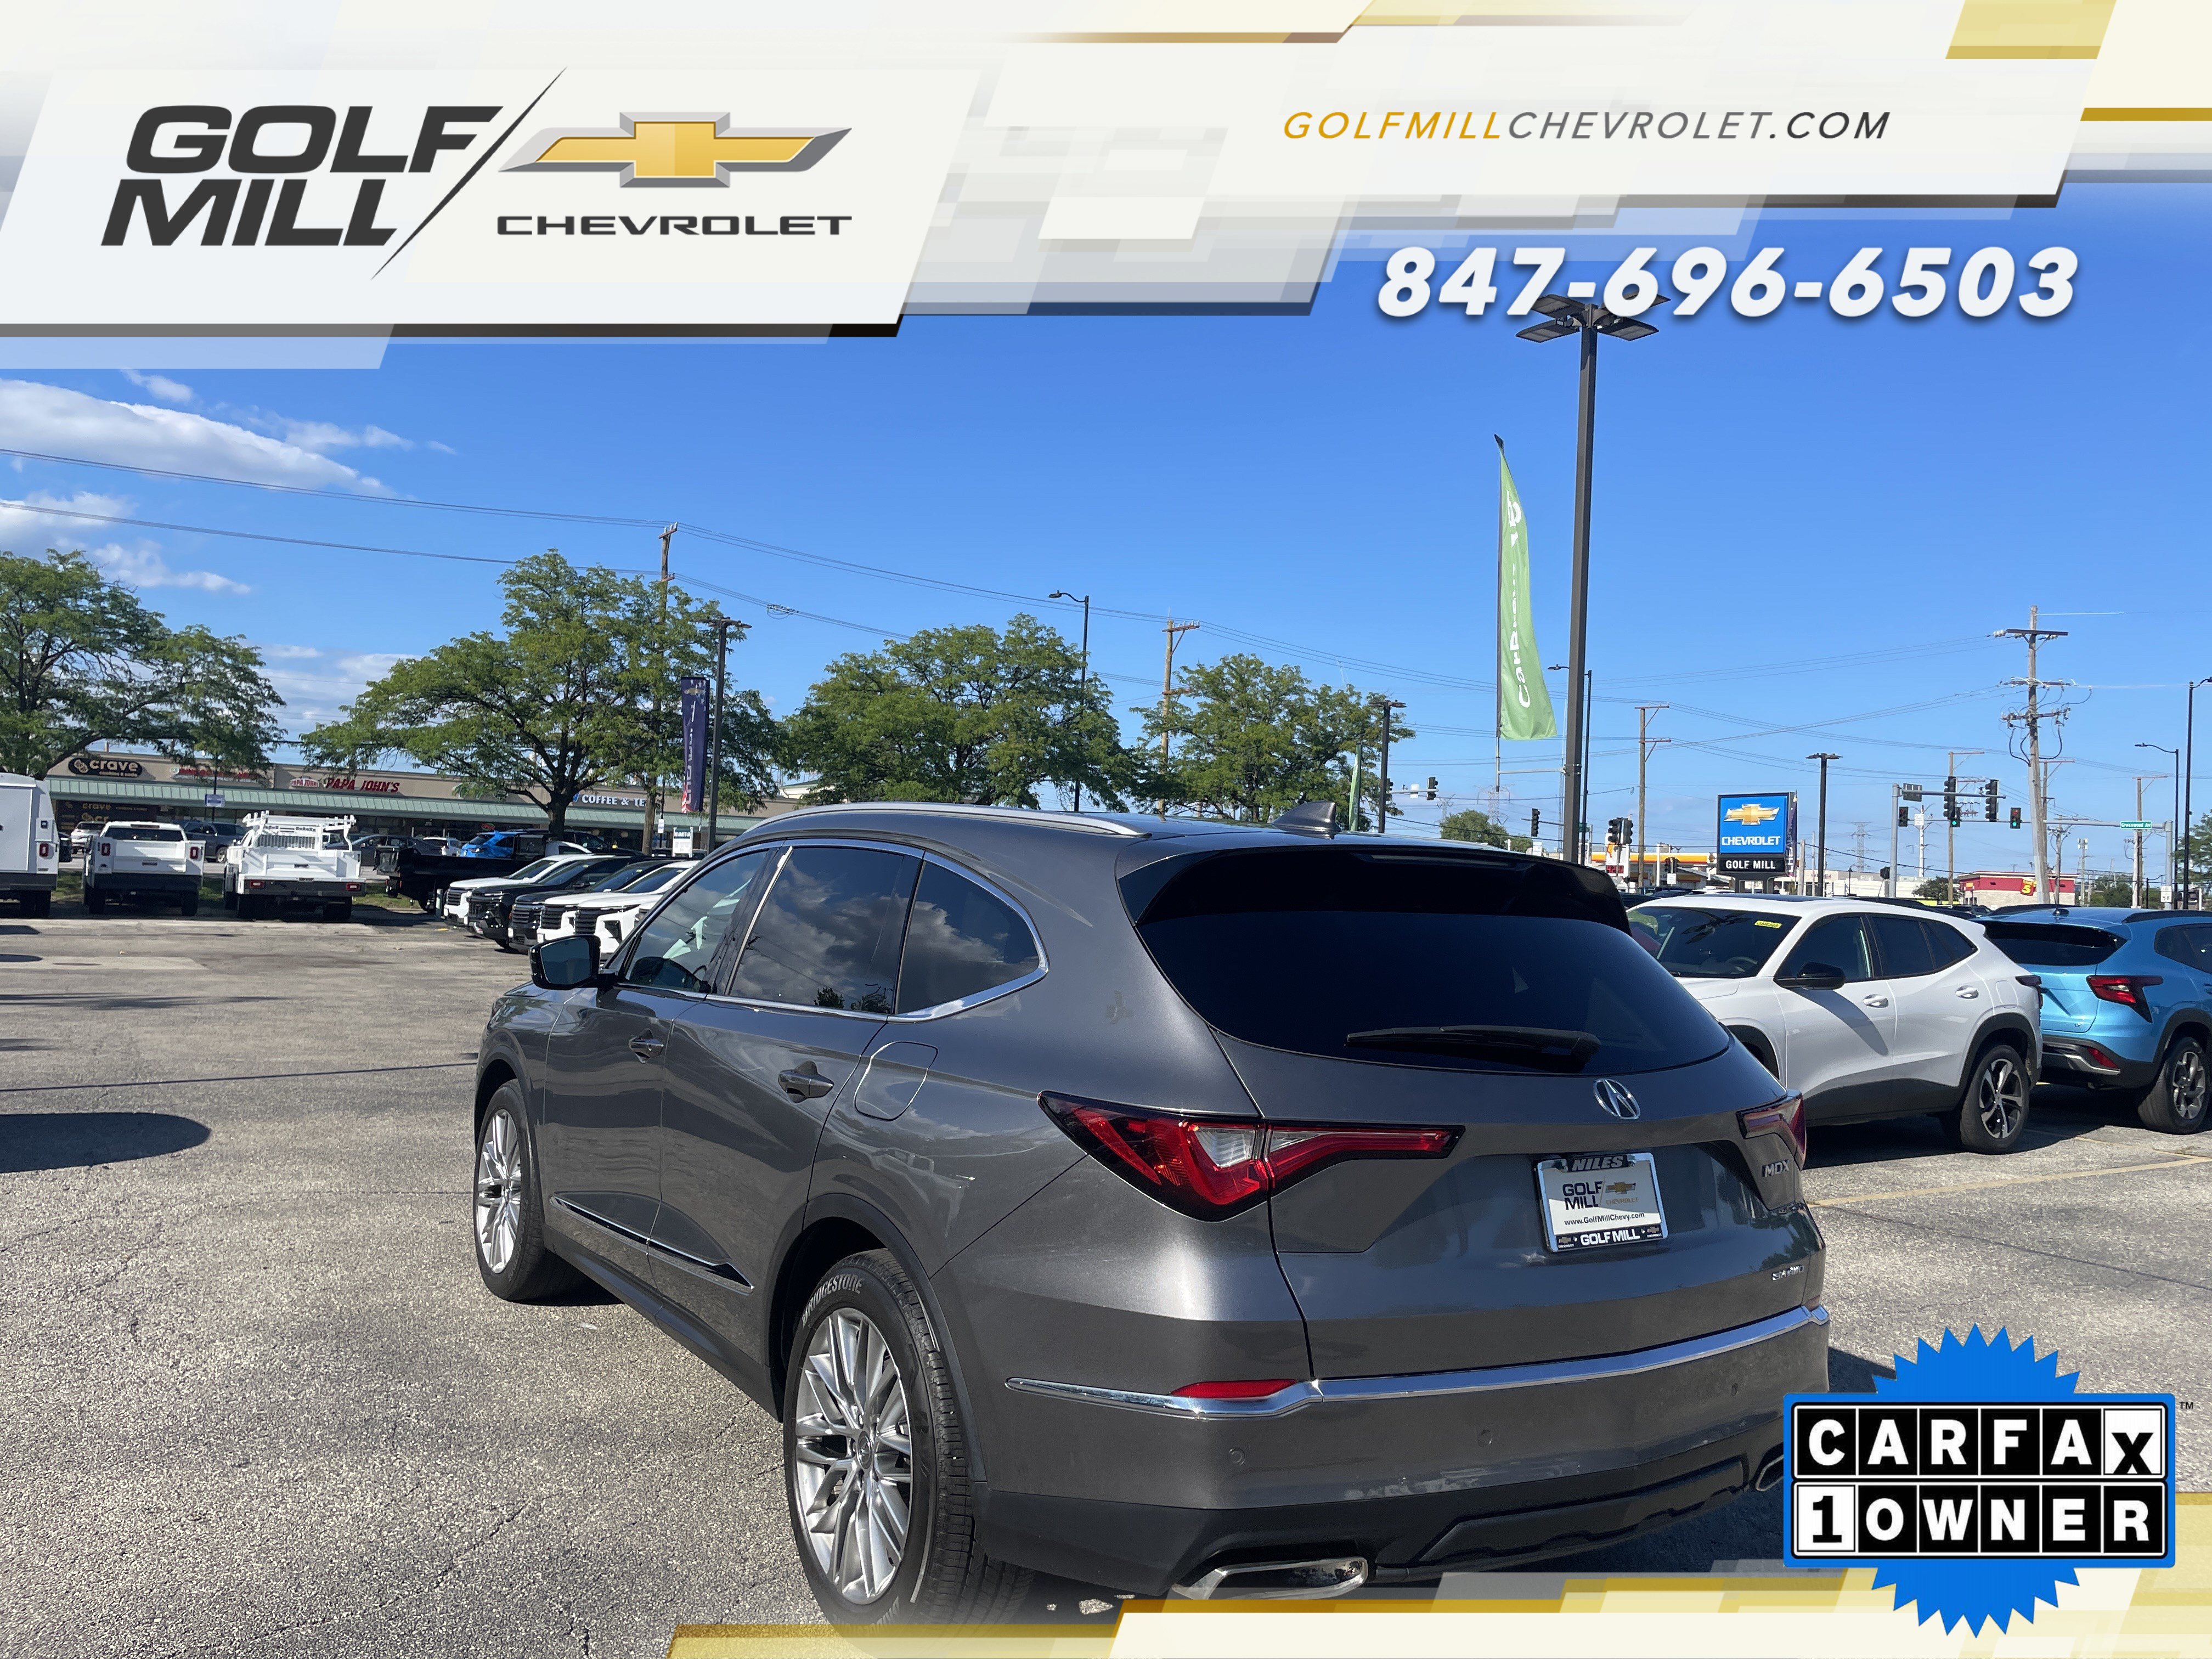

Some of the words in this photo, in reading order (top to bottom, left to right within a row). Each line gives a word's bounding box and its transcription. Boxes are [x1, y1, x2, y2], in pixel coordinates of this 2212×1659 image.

[89, 760, 138, 772] crave
[326, 778, 355, 790] PAPA
[360, 780, 400, 793] JOHN'S
[82, 803, 111, 811] crave
[582, 794, 617, 805] COFFEE
[621, 798, 630, 806] &
[634, 798, 646, 807] TE
[1722, 836, 1781, 846] CHEVROLET
[1725, 860, 1750, 869] GOLF
[1753, 860, 1776, 870] MILL
[1572, 1155, 1624, 1171] NILES
[1763, 1159, 1790, 1177] MDX
[1562, 1181, 1603, 1197] GOLF
[1565, 1195, 1599, 1210] MILL
[1564, 1212, 1645, 1226] www.GolfMillChevy.com
